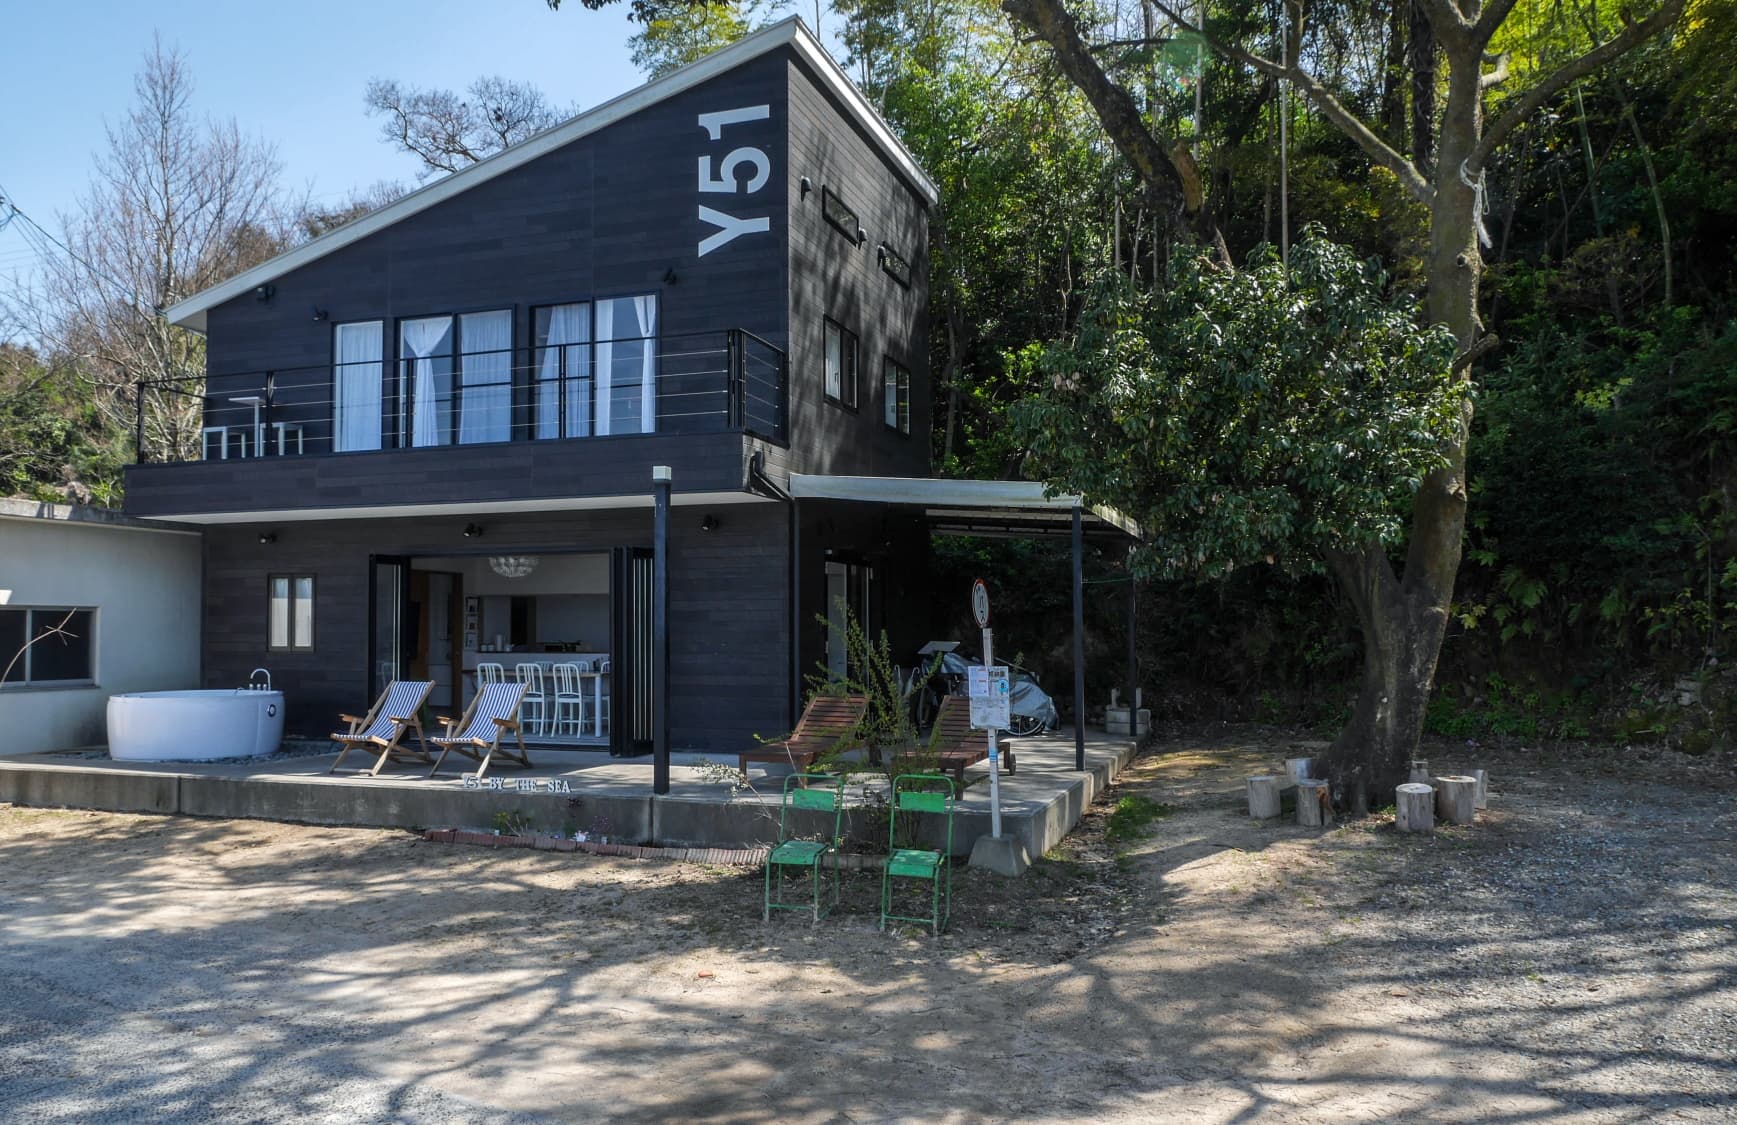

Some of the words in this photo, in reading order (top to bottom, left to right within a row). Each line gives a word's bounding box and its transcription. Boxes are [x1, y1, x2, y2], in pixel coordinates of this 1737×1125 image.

[698, 104, 770, 258] Y51
[488, 776, 505, 789] BY
[515, 778, 537, 792] THE
[547, 780, 571, 793] SEA
